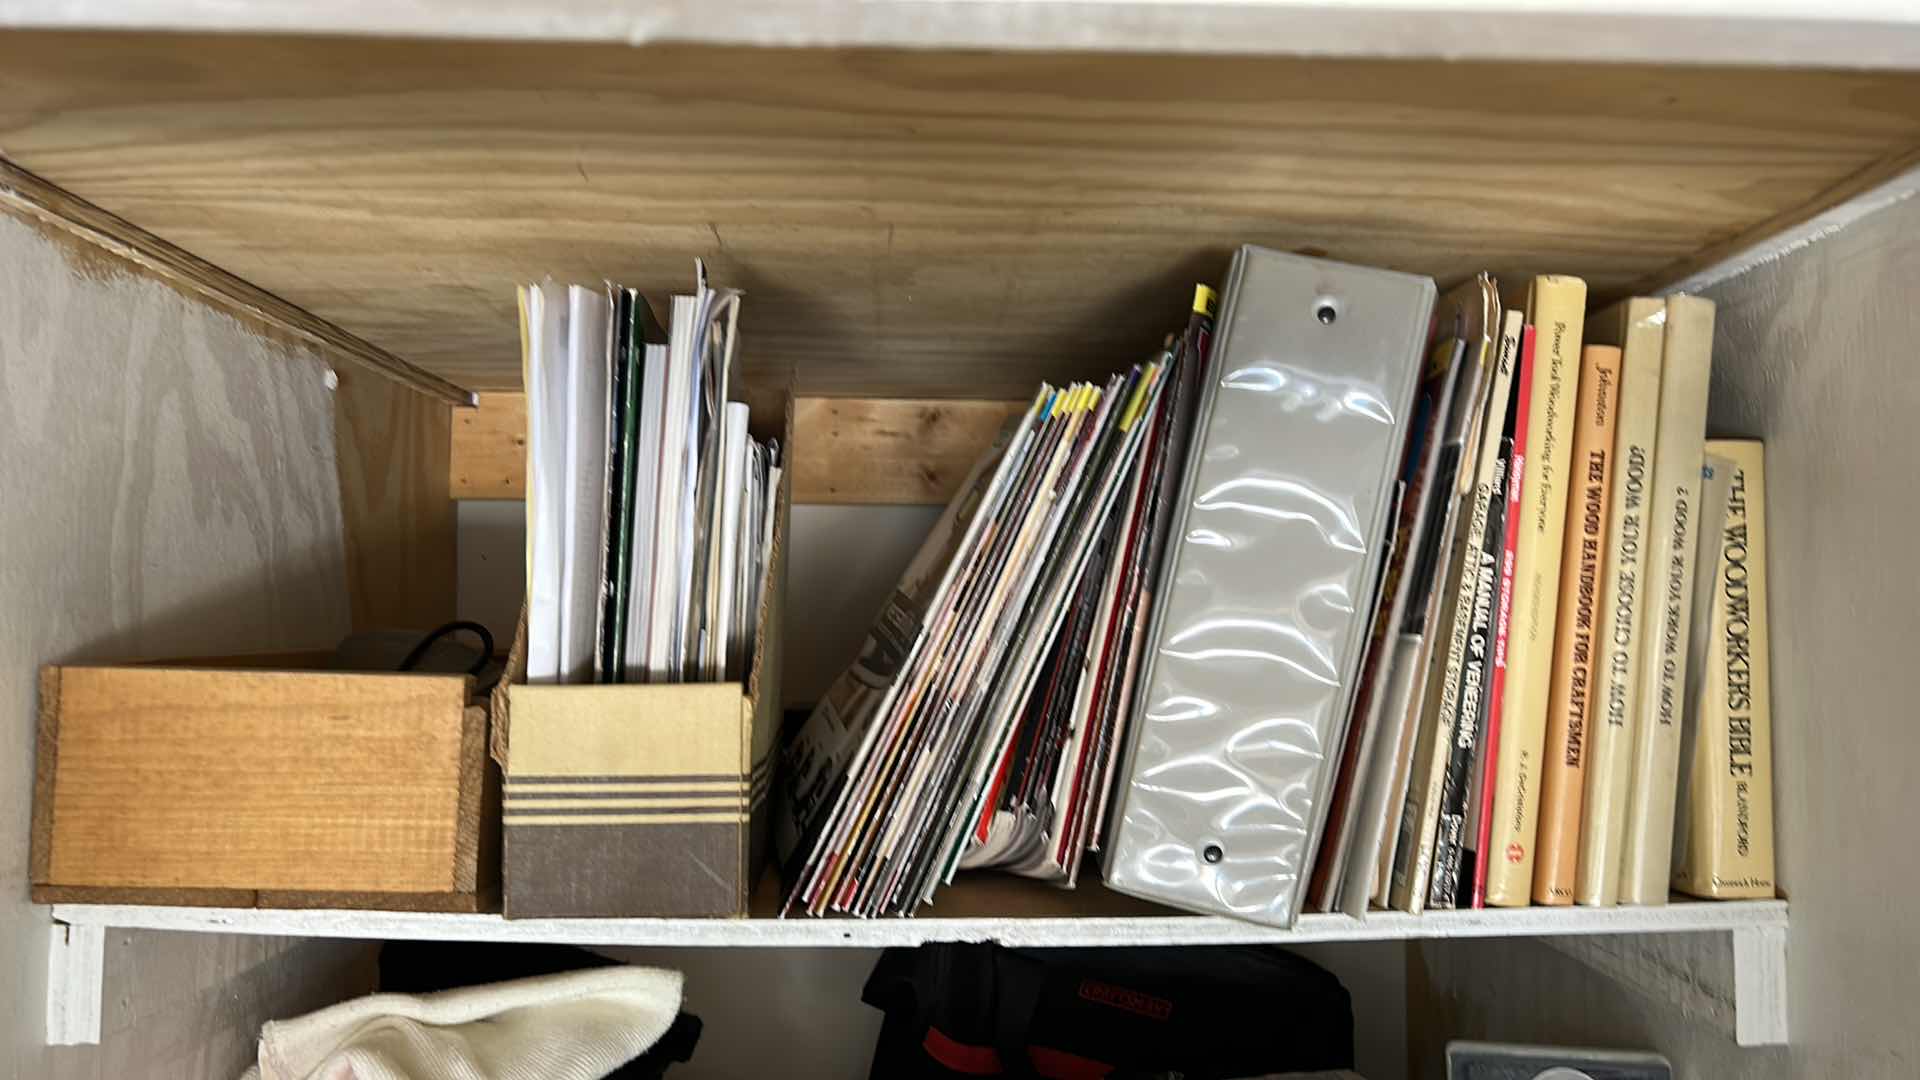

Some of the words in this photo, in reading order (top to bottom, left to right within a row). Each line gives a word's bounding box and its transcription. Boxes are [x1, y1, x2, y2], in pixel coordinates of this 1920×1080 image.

[1589, 449, 1606, 482] THE
[1624, 445, 1645, 509] WOOD?
[1584, 487, 1603, 536] WOOD
[1671, 500, 1688, 551] WOOD
[1480, 551, 1496, 567] A
[1619, 515, 1640, 565] YOUR
[1473, 569, 1494, 632] MANUAL
[1576, 538, 1600, 629] HANDBOOK
[1668, 554, 1685, 602] YOUR
[1613, 571, 1636, 647] CHOOSE
[1664, 604, 1681, 656] WORK
[1469, 633, 1485, 660] OF
[1573, 633, 1591, 665] FOR
[1611, 652, 1629, 675] TO
[1662, 660, 1676, 682] TO
[1458, 661, 1484, 749] VENEERING
[1565, 667, 1588, 768] CRAFTSMEN
[1607, 682, 1627, 728] HOW
[1659, 683, 1674, 726] HOW
[1729, 716, 1752, 777] BIBLE
